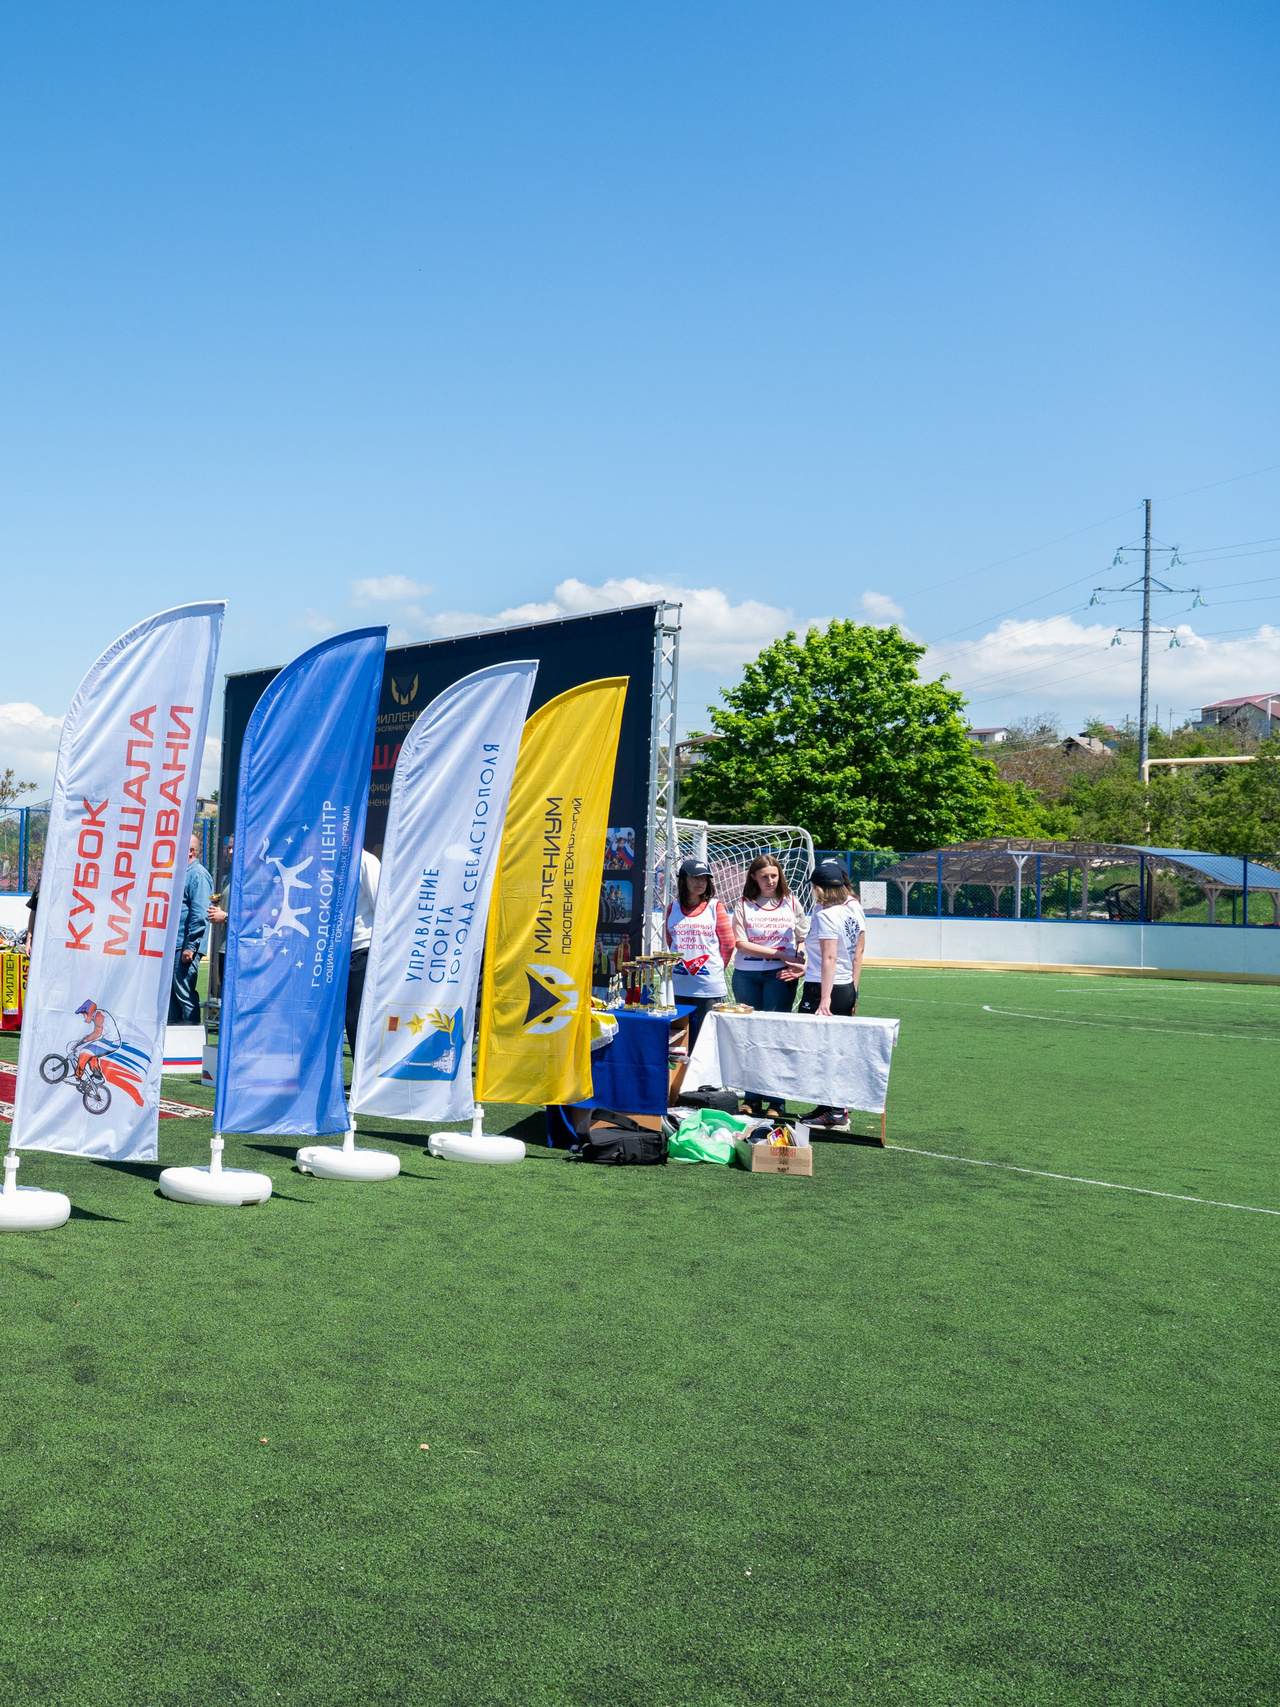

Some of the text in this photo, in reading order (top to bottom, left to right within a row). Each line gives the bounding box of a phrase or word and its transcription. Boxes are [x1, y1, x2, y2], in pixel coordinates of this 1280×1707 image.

[65, 797, 109, 951] КУБОК
[103, 704, 157, 956] МАРШАЛА
[138, 705, 194, 958] ГЕЛОВАНИ
[311, 800, 337, 987] ГОРОДСКОЙ ЦЕНТР
[342, 805, 351, 852] ПРОГРАММ
[447, 744, 500, 983] ГОРОДА СЕВАСТОПОЛЯ
[534, 797, 563, 954] МИЛЛЕНИУМ
[405, 868, 439, 982] УПРАВЛЕНИЕ
[428, 906, 454, 983] СПОРТА
[562, 879, 574, 955] ПОКОЛЕНИЕ
